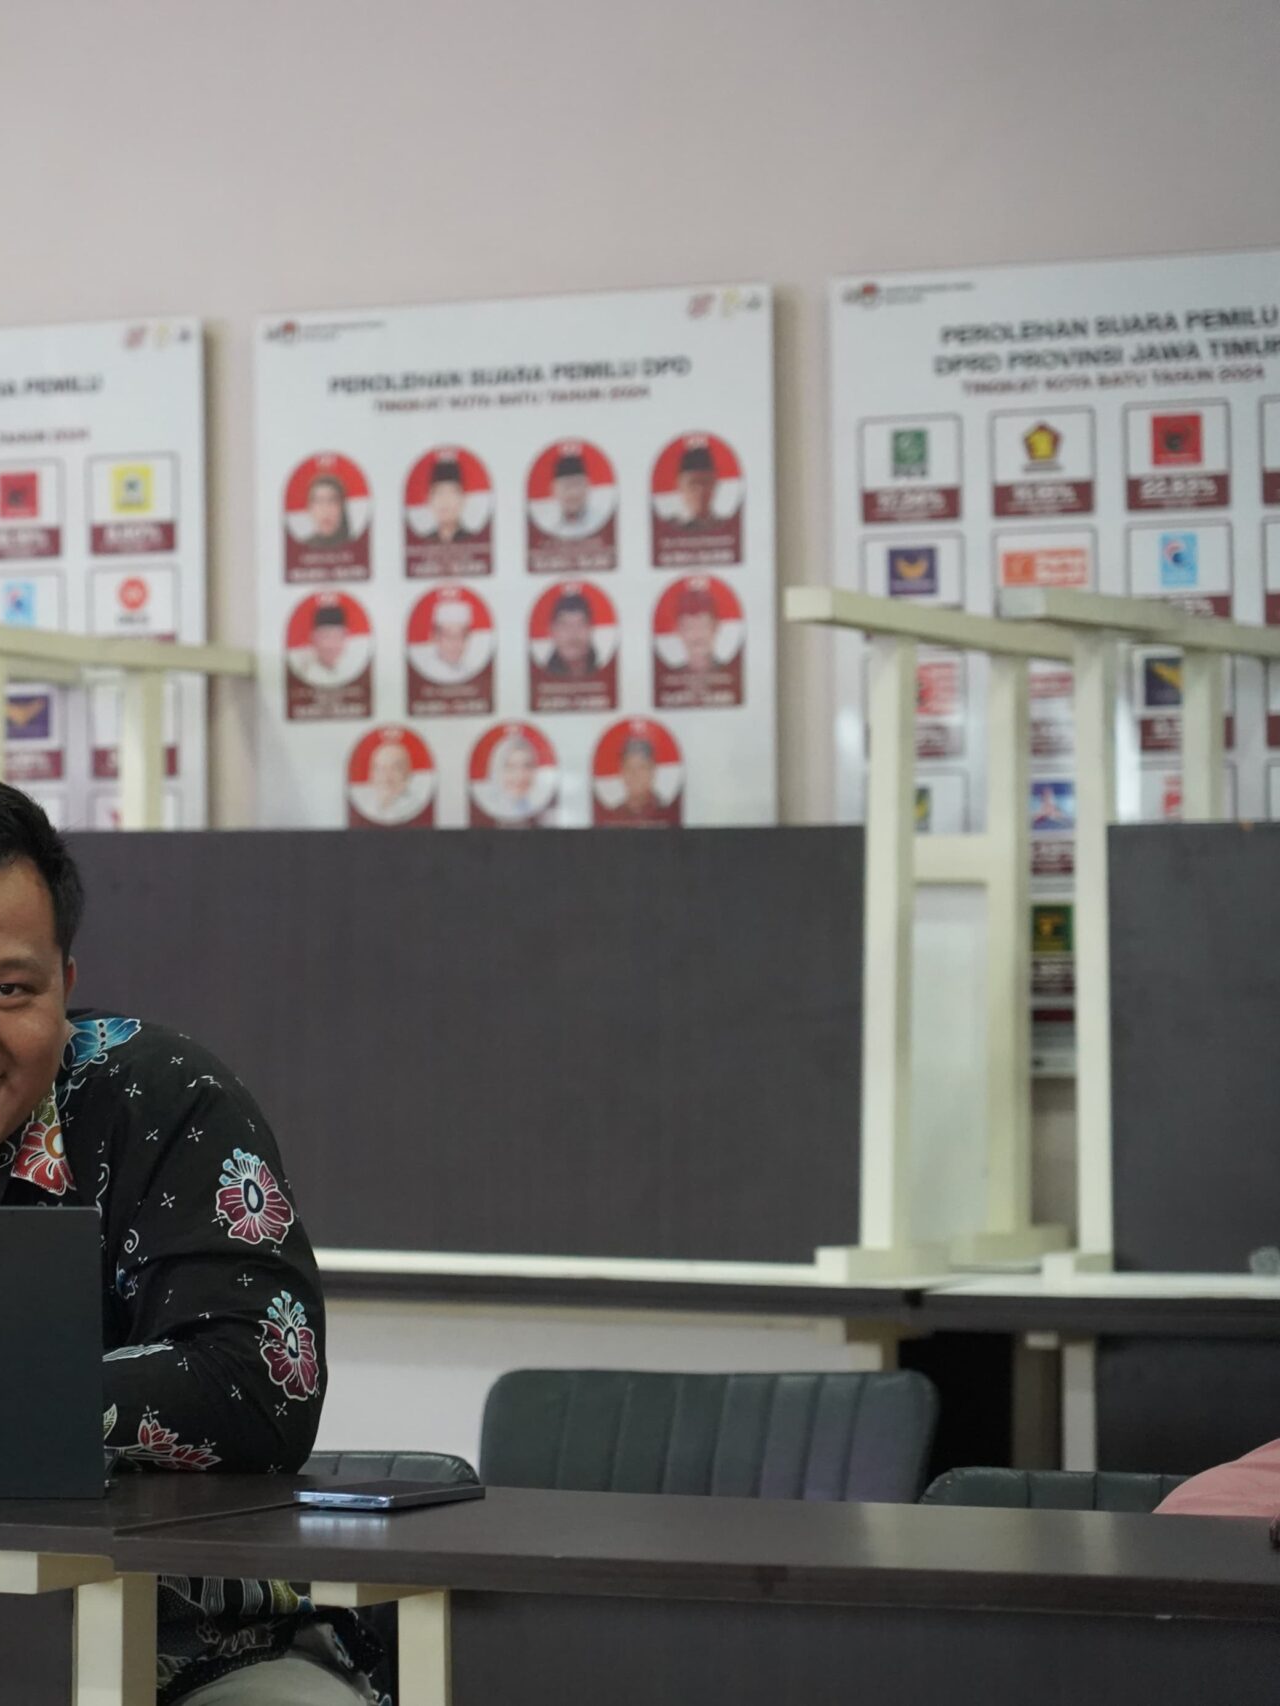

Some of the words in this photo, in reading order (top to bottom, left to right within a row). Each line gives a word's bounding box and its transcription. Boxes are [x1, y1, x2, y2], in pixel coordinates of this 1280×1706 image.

[940, 319, 1088, 345] PEROLEHAN
[1095, 312, 1179, 337] SUARA
[1186, 305, 1279, 330] PEMILU
[328, 369, 462, 395] PEROLEHAN
[471, 363, 543, 387] SUARA
[552, 359, 636, 382] PEMILU
[642, 354, 692, 377] DPD
[933, 354, 1002, 377] DPRD
[1007, 346, 1123, 371] PROVINSI
[1131, 340, 1200, 364] JAWA
[1045, 373, 1093, 392] KOTA
[1098, 370, 1147, 388] BATU
[1152, 366, 1214, 385] TAHUN
[1220, 362, 1264, 381] 2024
[23, 373, 102, 394] PEMILU
